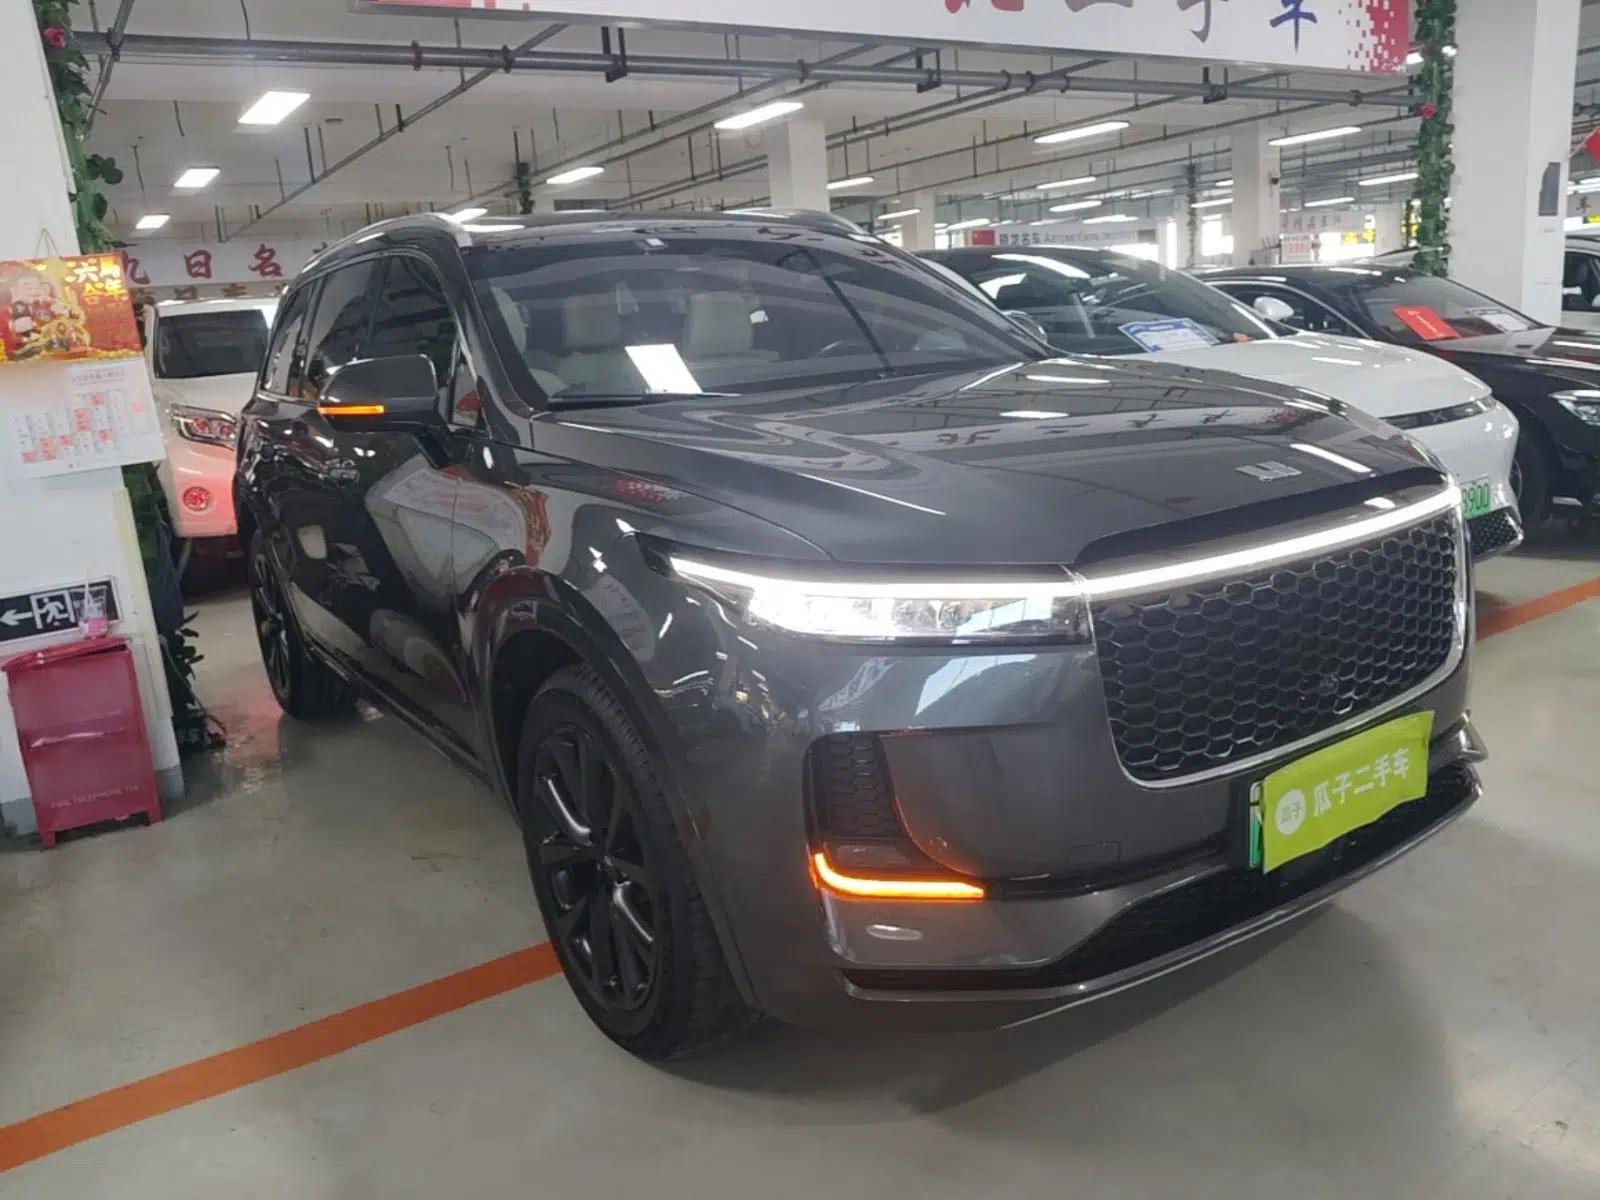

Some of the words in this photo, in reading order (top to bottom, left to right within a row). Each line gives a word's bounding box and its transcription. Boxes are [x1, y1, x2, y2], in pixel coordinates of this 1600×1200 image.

[1313, 748, 1409, 817] 瓜子二手车
